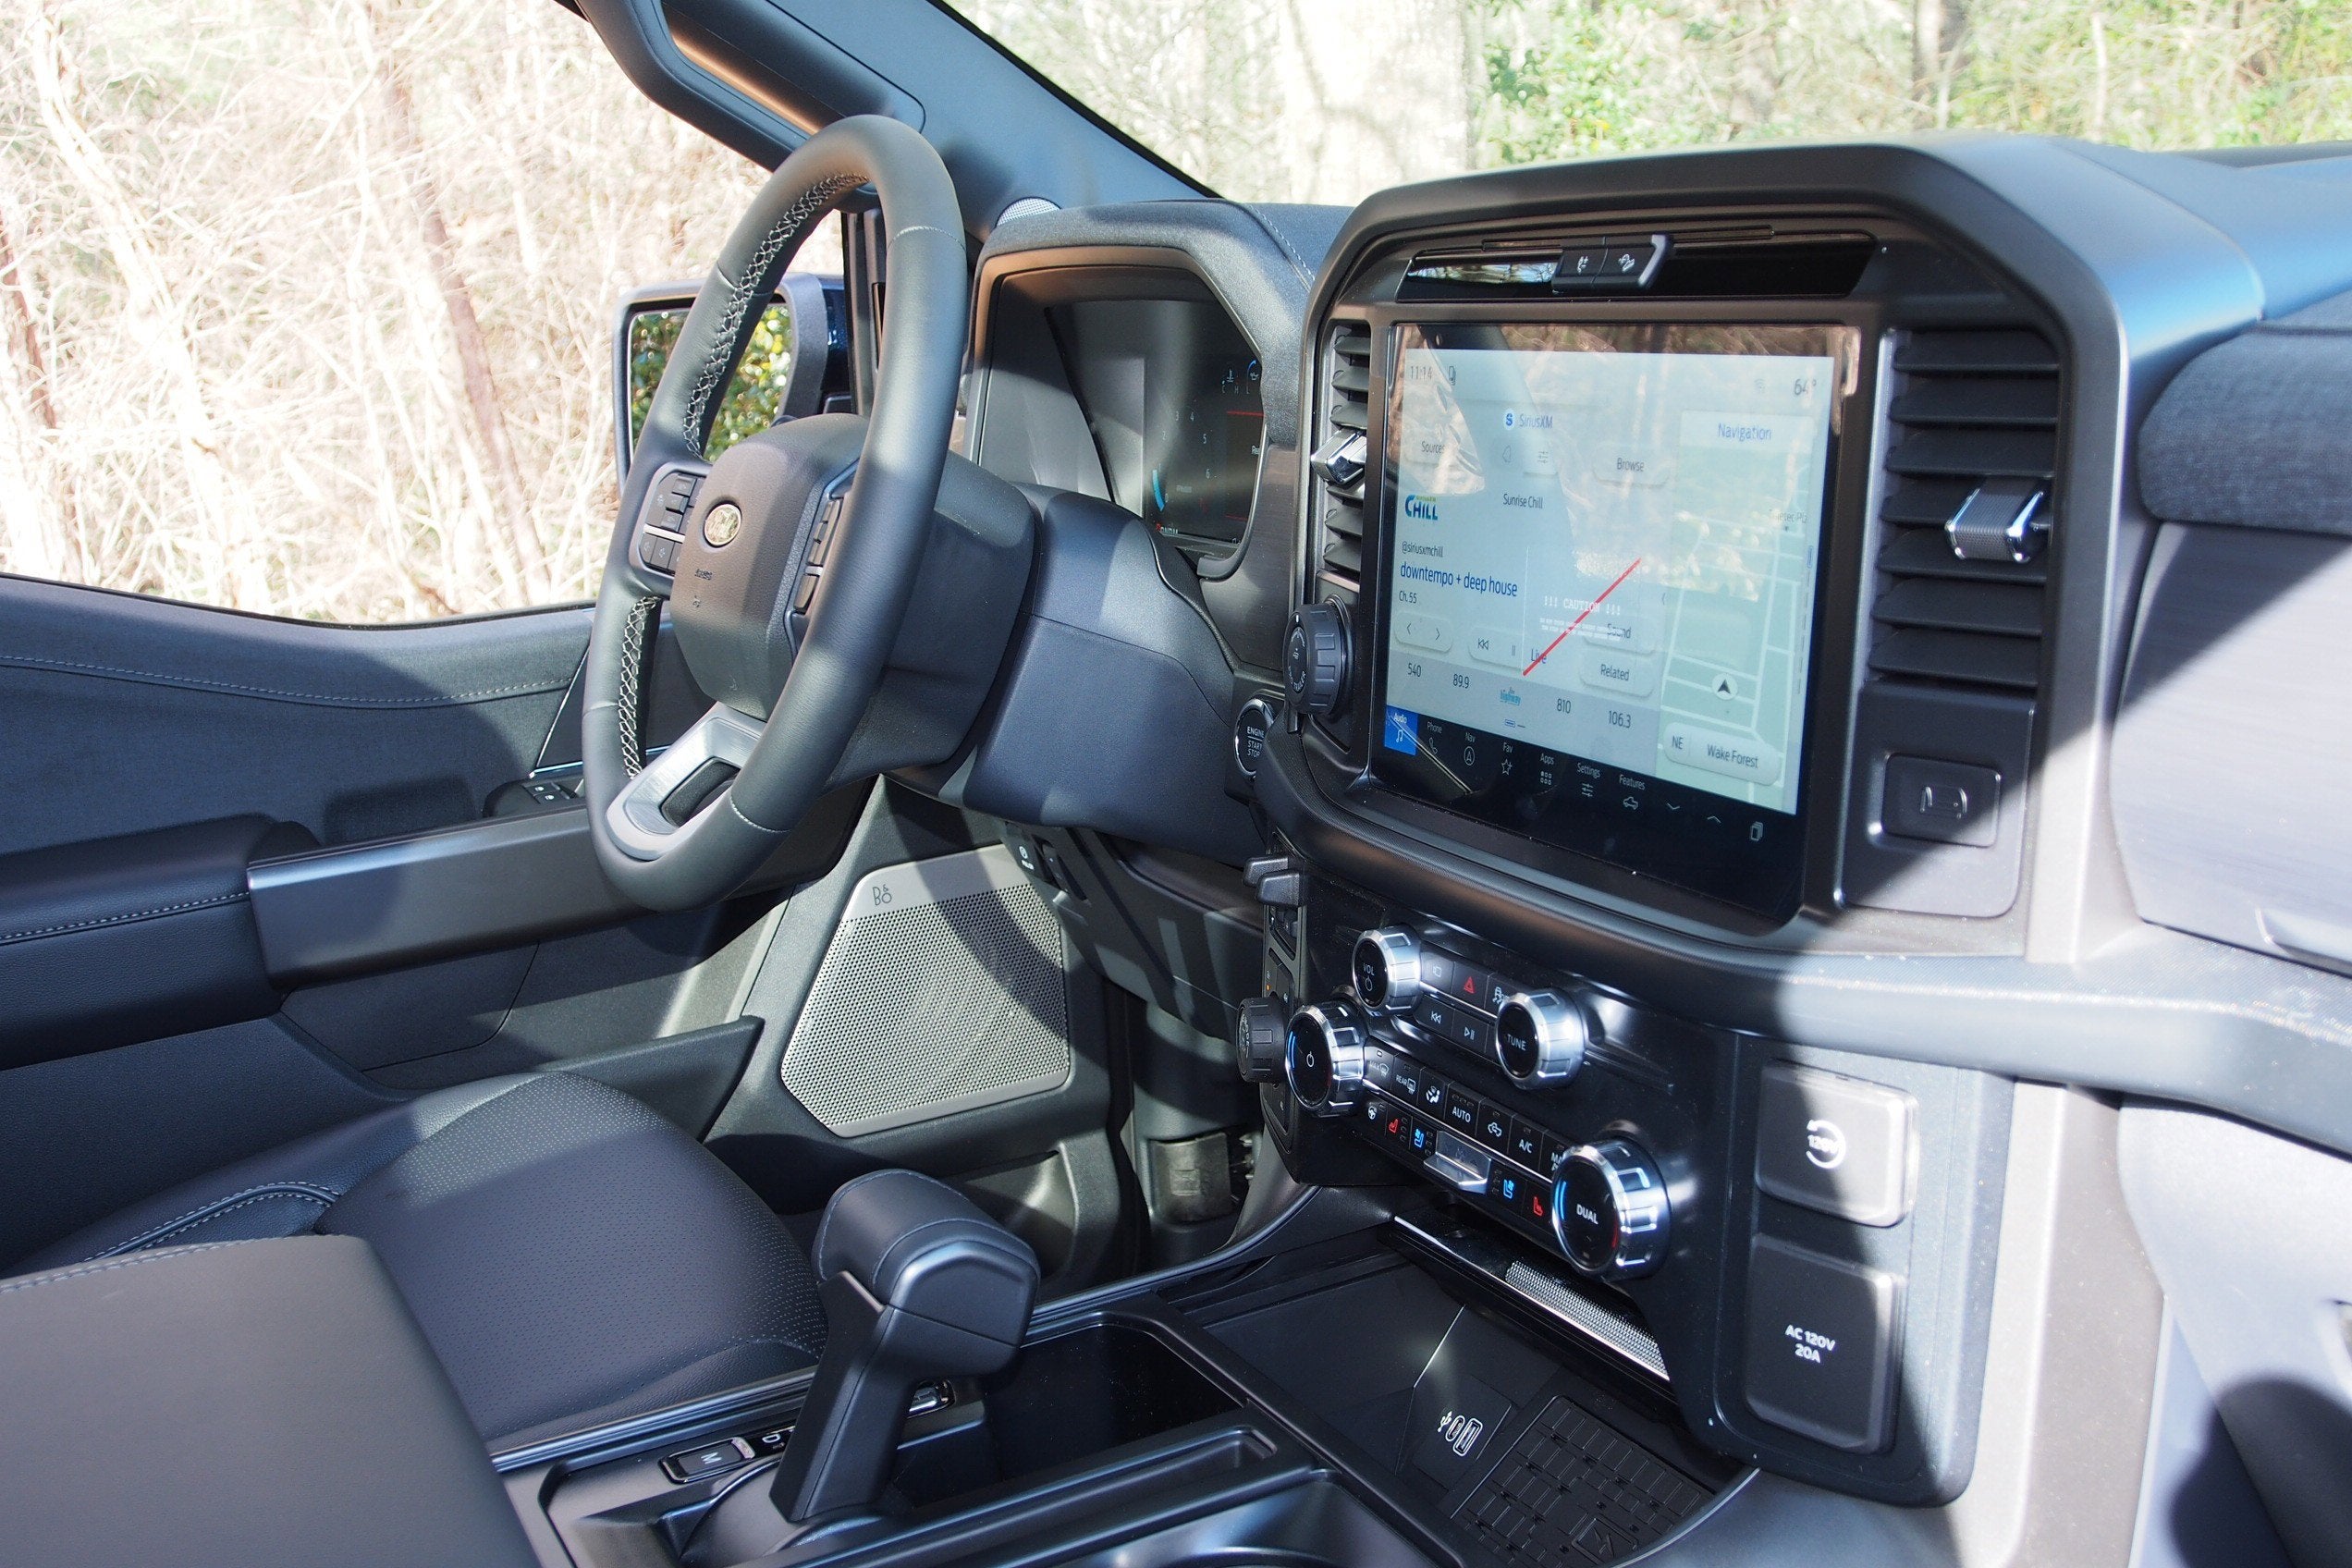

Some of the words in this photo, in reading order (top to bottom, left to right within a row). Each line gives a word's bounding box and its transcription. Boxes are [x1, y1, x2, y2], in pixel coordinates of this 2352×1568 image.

[1410, 365, 1432, 380] 11:14
[1519, 415, 1553, 430] SiriusXM
[1718, 423, 1772, 442] Navigation
[1421, 440, 1446, 455] Sources
[1616, 457, 1645, 472] Browse
[1404, 494, 1439, 521] CHILL
[1503, 493, 1527, 508] Sunrise
[1528, 496, 1544, 509] Chill
[1401, 541, 1443, 557] @siriusxmchill
[1400, 561, 1454, 587] downtempo
[1456, 574, 1462, 584] +
[1464, 571, 1488, 594] deep
[1489, 575, 1518, 597] house
[1544, 595, 1558, 607] !!!
[1563, 598, 1600, 613] CAUTION
[1606, 604, 1621, 616] !!!
[1407, 663, 1422, 677] 540
[1600, 663, 1630, 681] Related
[1452, 673, 1470, 689] 89.9
[1556, 698, 1572, 714] 810
[1393, 713, 1407, 724] Audio
[1608, 710, 1632, 729] 106.3
[1246, 726, 1265, 739] ENGINE
[1427, 721, 1443, 734] Phone
[1464, 732, 1476, 743] Nav
[1247, 740, 1263, 752] START
[1502, 741, 1513, 753] Fav
[1672, 735, 1684, 750] NE
[1707, 743, 1731, 762] Wake
[1732, 749, 1758, 769] Forest
[1540, 753, 1554, 766] Apps
[1576, 762, 1600, 778] Settings
[1619, 774, 1646, 790] Features
[1363, 962, 1375, 976] VOL
[1506, 1034, 1526, 1051] TUNE
[1395, 1074, 1408, 1086] REAR
[1452, 1106, 1471, 1122] AUTO
[1518, 1139, 1533, 1154] A/C
[1575, 1204, 1599, 1225] DUAL
[1785, 1324, 1803, 1341] AC
[1804, 1330, 1836, 1351] 120V
[1795, 1342, 1820, 1364] 20A
[761, 1433, 781, 1444] D
[700, 1452, 722, 1464] M
